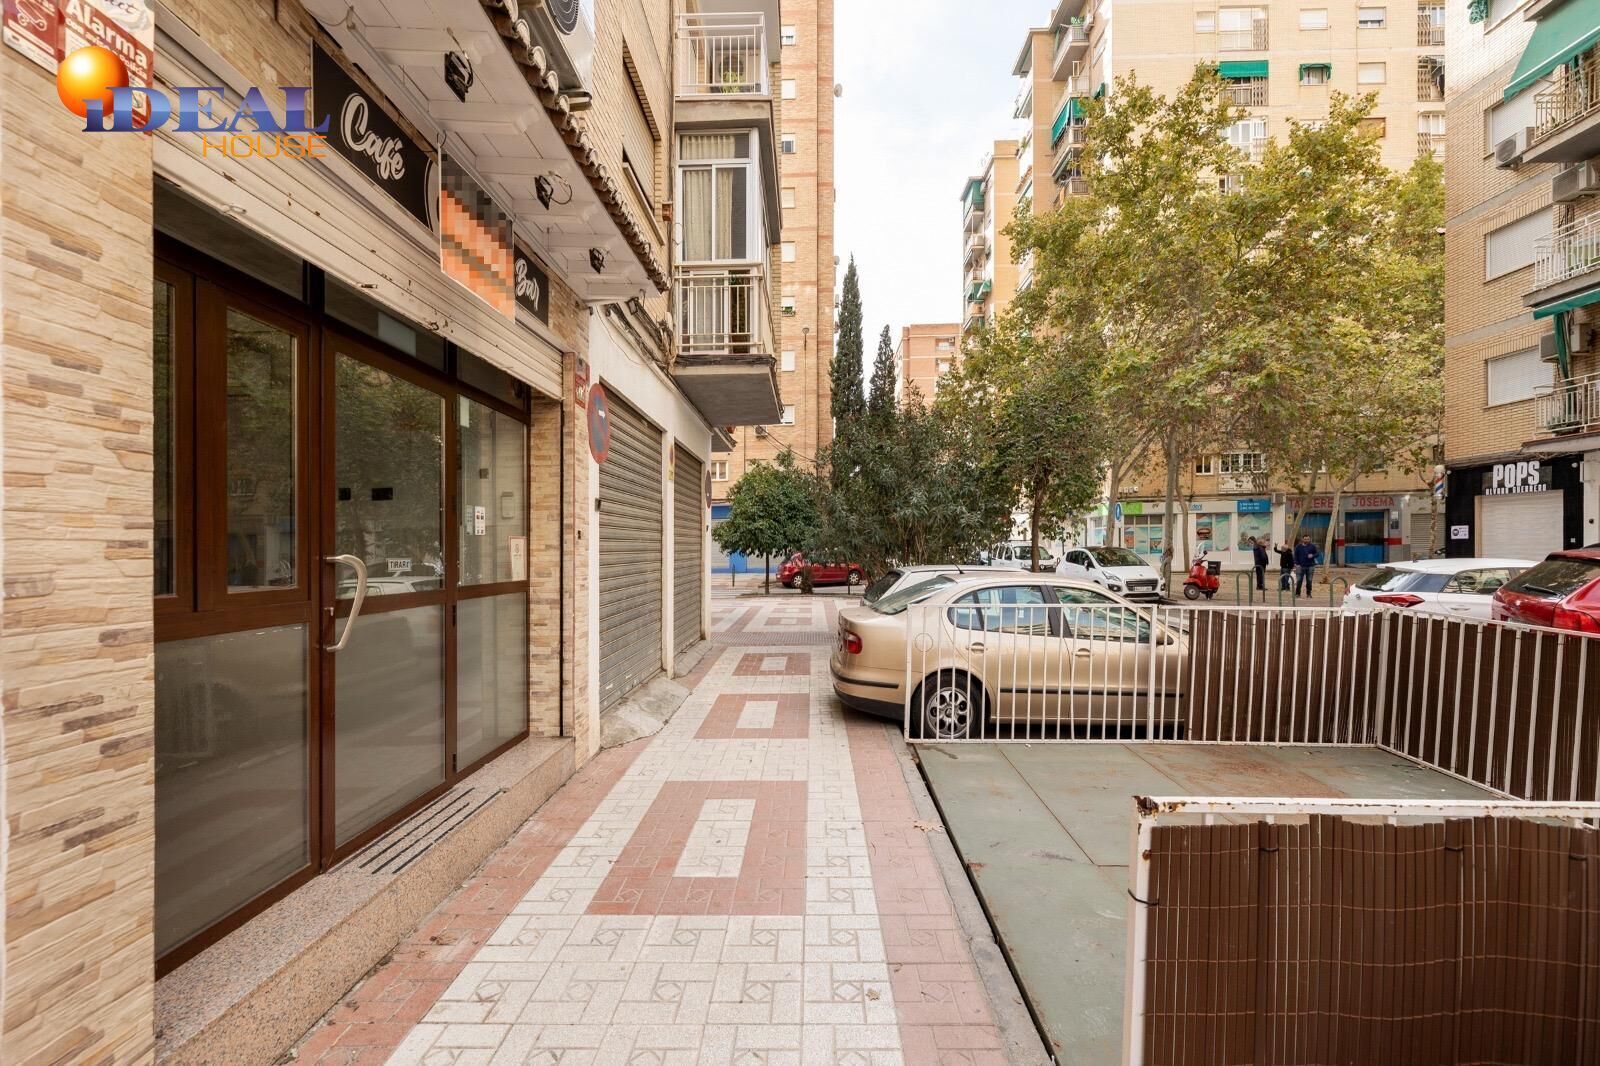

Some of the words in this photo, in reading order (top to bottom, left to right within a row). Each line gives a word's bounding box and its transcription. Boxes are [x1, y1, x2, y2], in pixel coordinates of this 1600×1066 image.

[65, 0, 148, 69] Alarma
[340, 92, 406, 181] Café
[515, 257, 540, 312] Bar
[1352, 495, 1395, 508] JOSEMA
[1492, 460, 1541, 489] POPS
